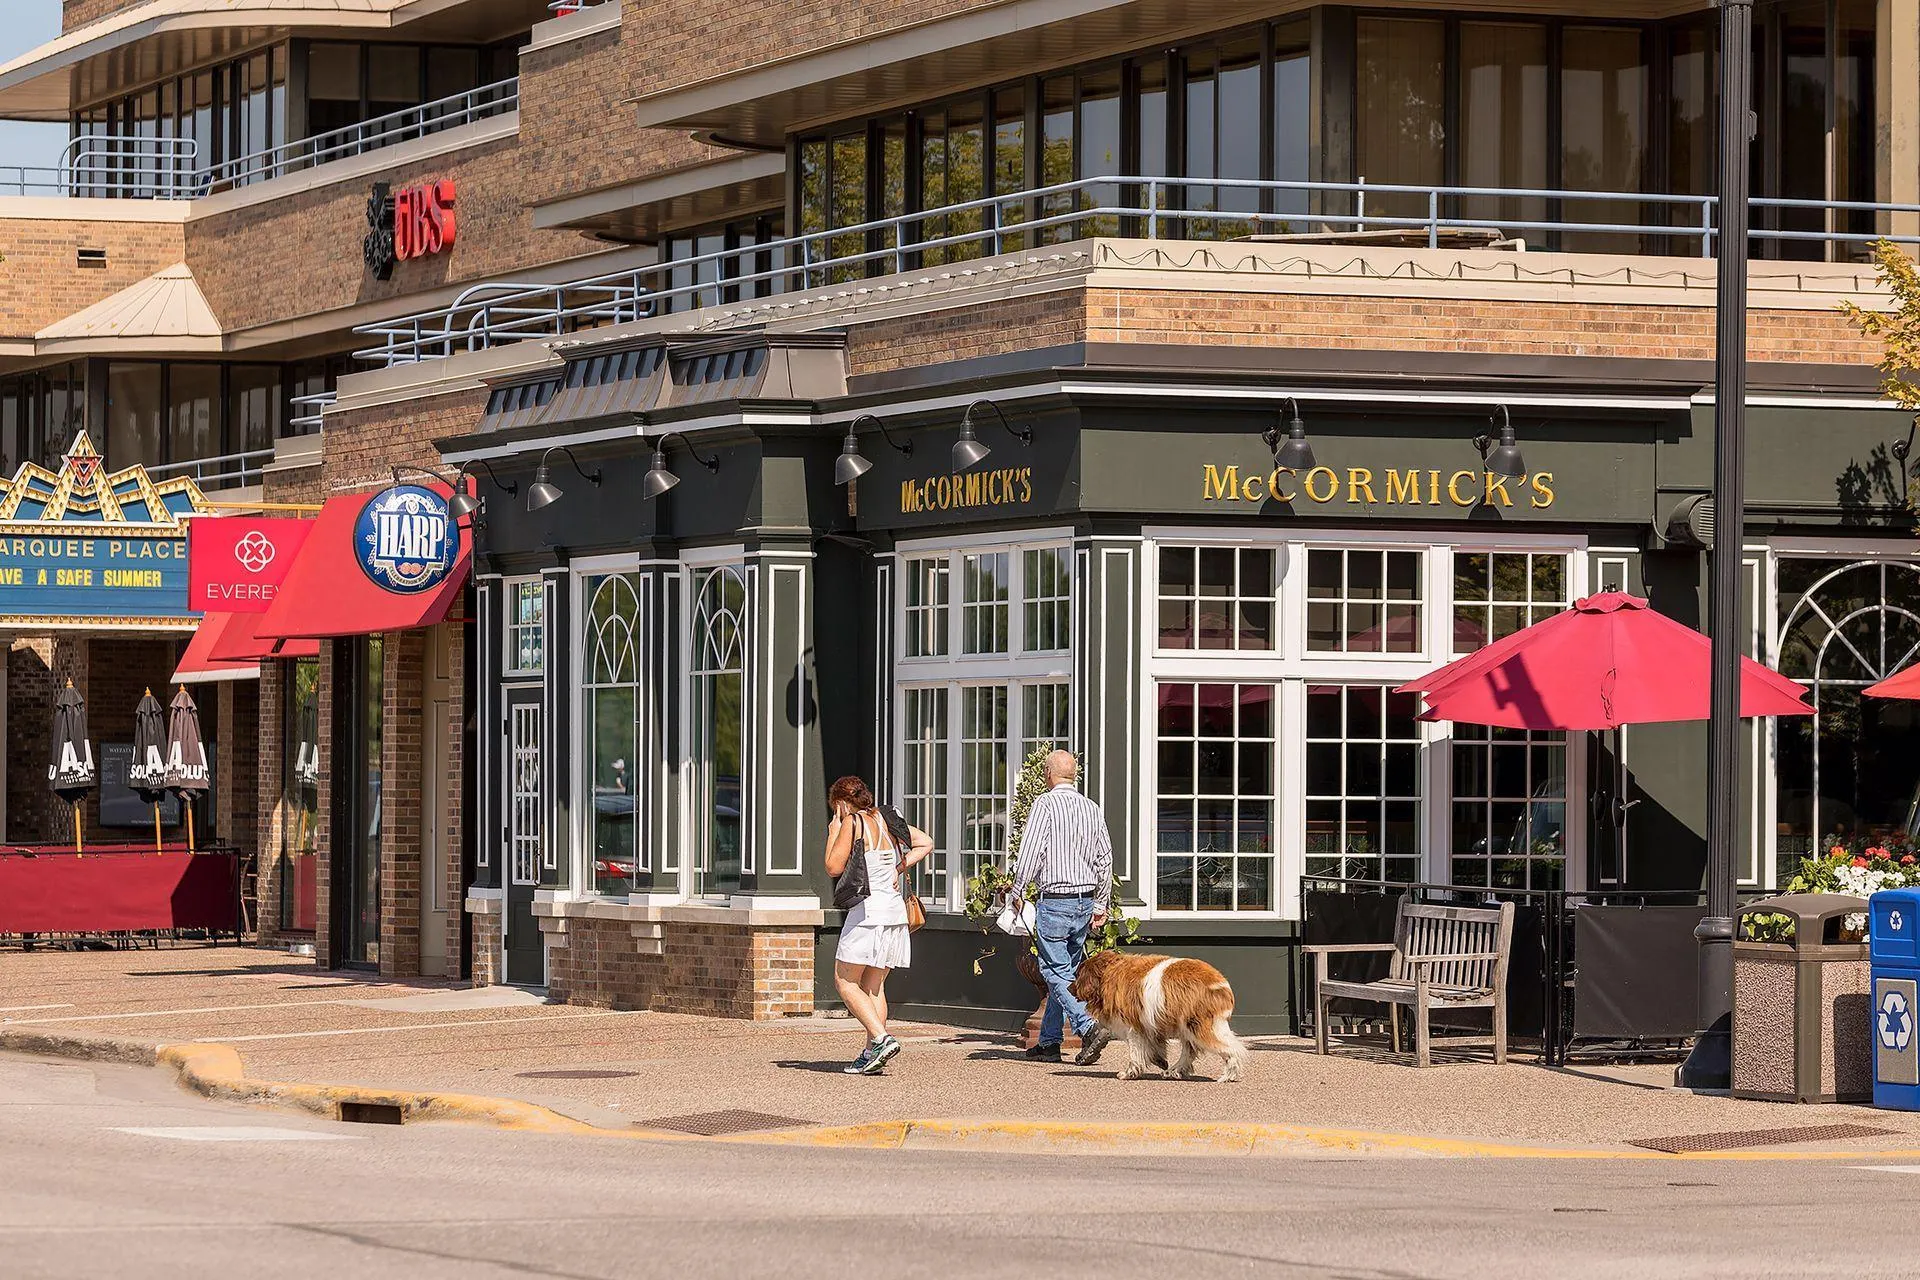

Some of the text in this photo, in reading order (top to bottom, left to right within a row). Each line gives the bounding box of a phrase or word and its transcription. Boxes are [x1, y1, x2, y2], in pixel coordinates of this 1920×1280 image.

[394, 180, 456, 262] UBS
[901, 467, 1032, 513] McCORMICK'S
[1203, 464, 1554, 508] McCORMICK'S
[110, 541, 186, 559] PLACE
[37, 569, 48, 586] A
[56, 569, 93, 586] SAFE
[103, 570, 162, 587] SUMMER
